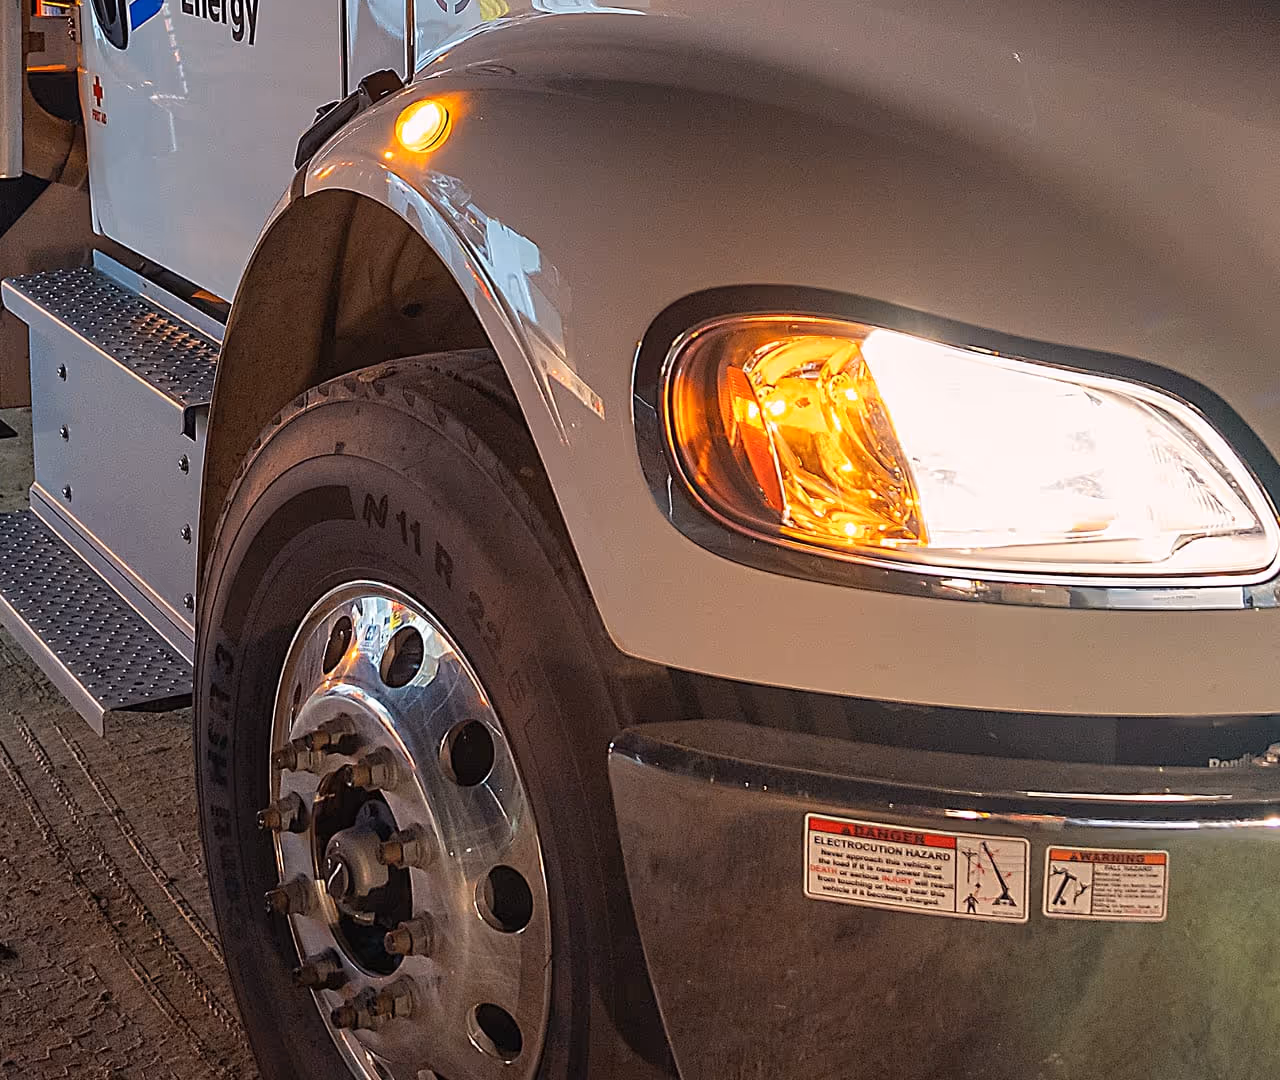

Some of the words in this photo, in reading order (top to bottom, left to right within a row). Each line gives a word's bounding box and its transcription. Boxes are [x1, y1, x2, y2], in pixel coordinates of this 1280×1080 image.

[854, 825, 925, 844] DANGER
[814, 836, 902, 855] ELECTROCUTION
[906, 848, 951, 861] HAZARD
[1080, 853, 1145, 863] WARNING
[819, 857, 830, 865] the
[833, 859, 849, 868] load
[876, 866, 894, 874] near
[896, 868, 920, 878] power
[821, 849, 843, 857] Never
[846, 853, 883, 864] approach
[886, 858, 900, 866] this
[903, 860, 931, 870] vehicle
[810, 864, 837, 874] DEATH
[850, 870, 879, 880] serious
[882, 876, 913, 884] INJURY
[914, 878, 928, 886] will
[930, 881, 954, 889] result
[817, 875, 836, 883] from
[838, 877, 872, 890] touching
[886, 883, 907, 894] being
[823, 885, 850, 894] vehicle
[867, 890, 903, 901] becomes
